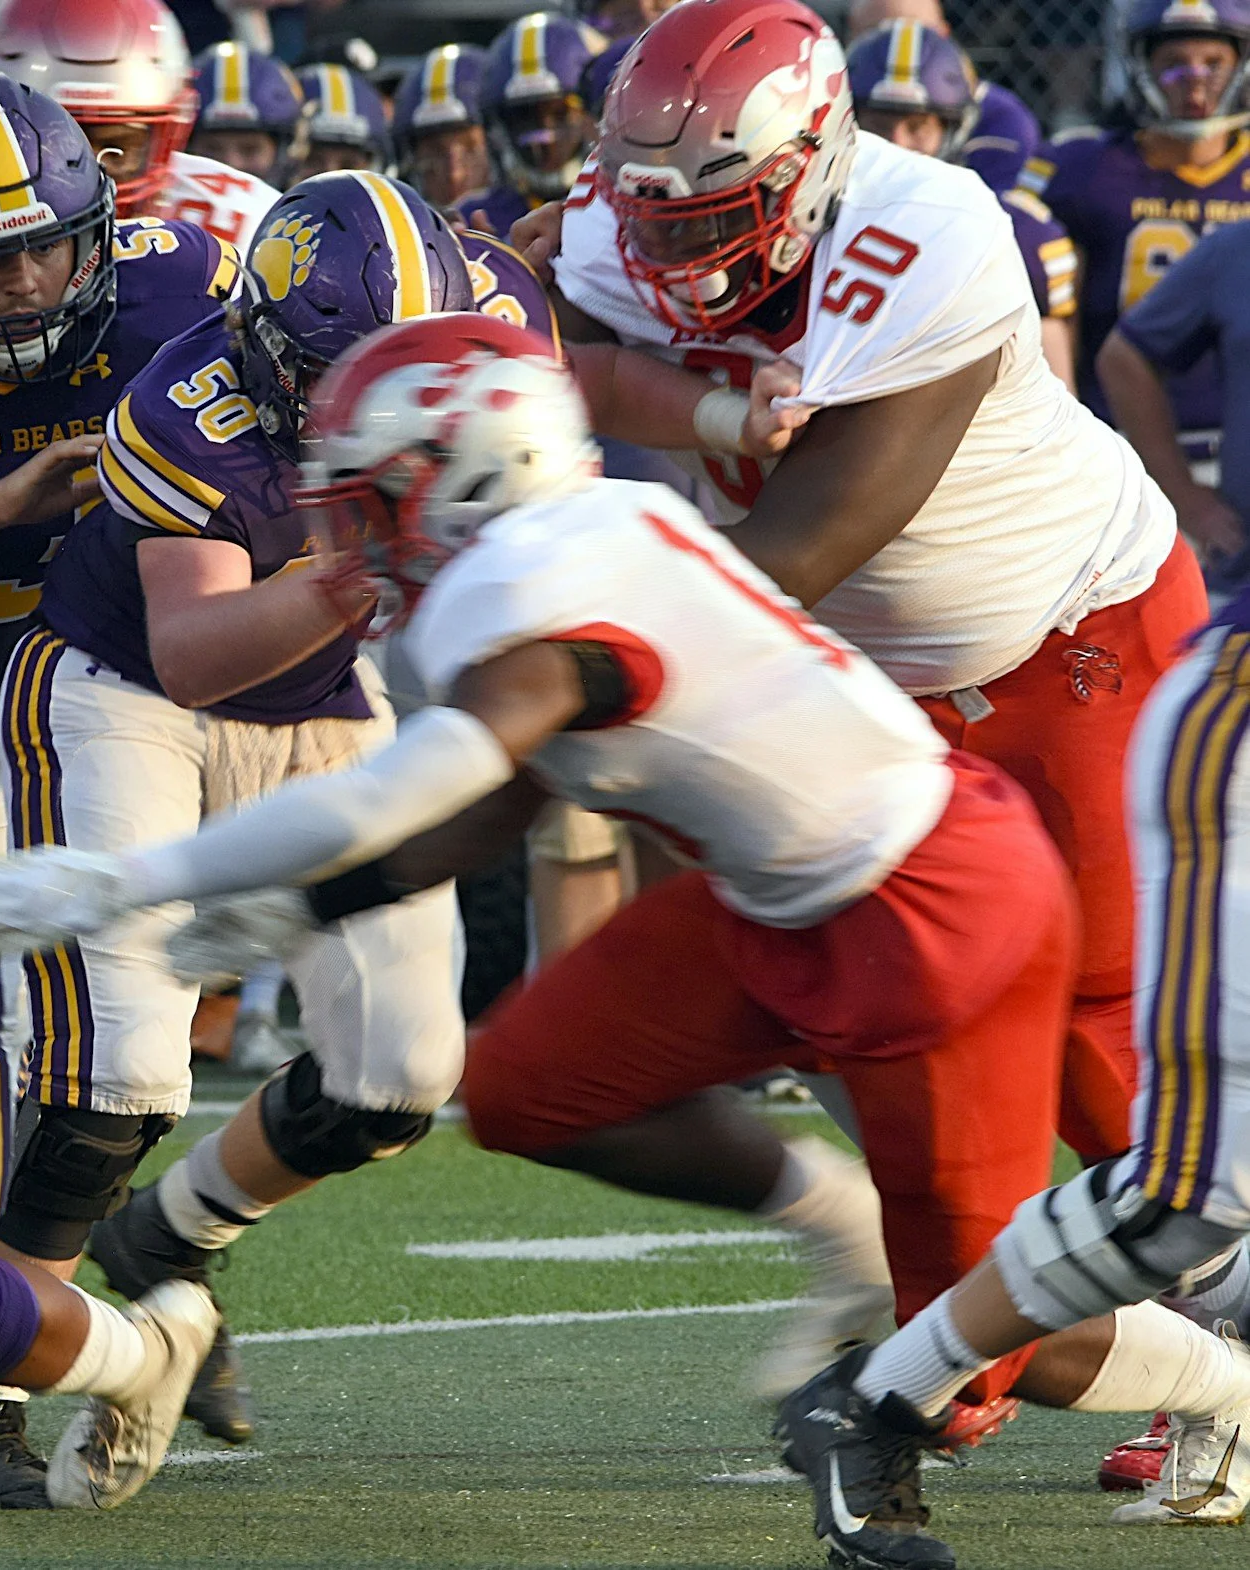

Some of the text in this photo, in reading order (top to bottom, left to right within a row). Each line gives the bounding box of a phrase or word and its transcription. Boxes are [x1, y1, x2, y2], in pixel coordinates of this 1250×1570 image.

[174, 172, 253, 245] 24
[819, 225, 921, 327] 50
[12, 416, 103, 452] BEARS
[166, 357, 259, 443] 50
